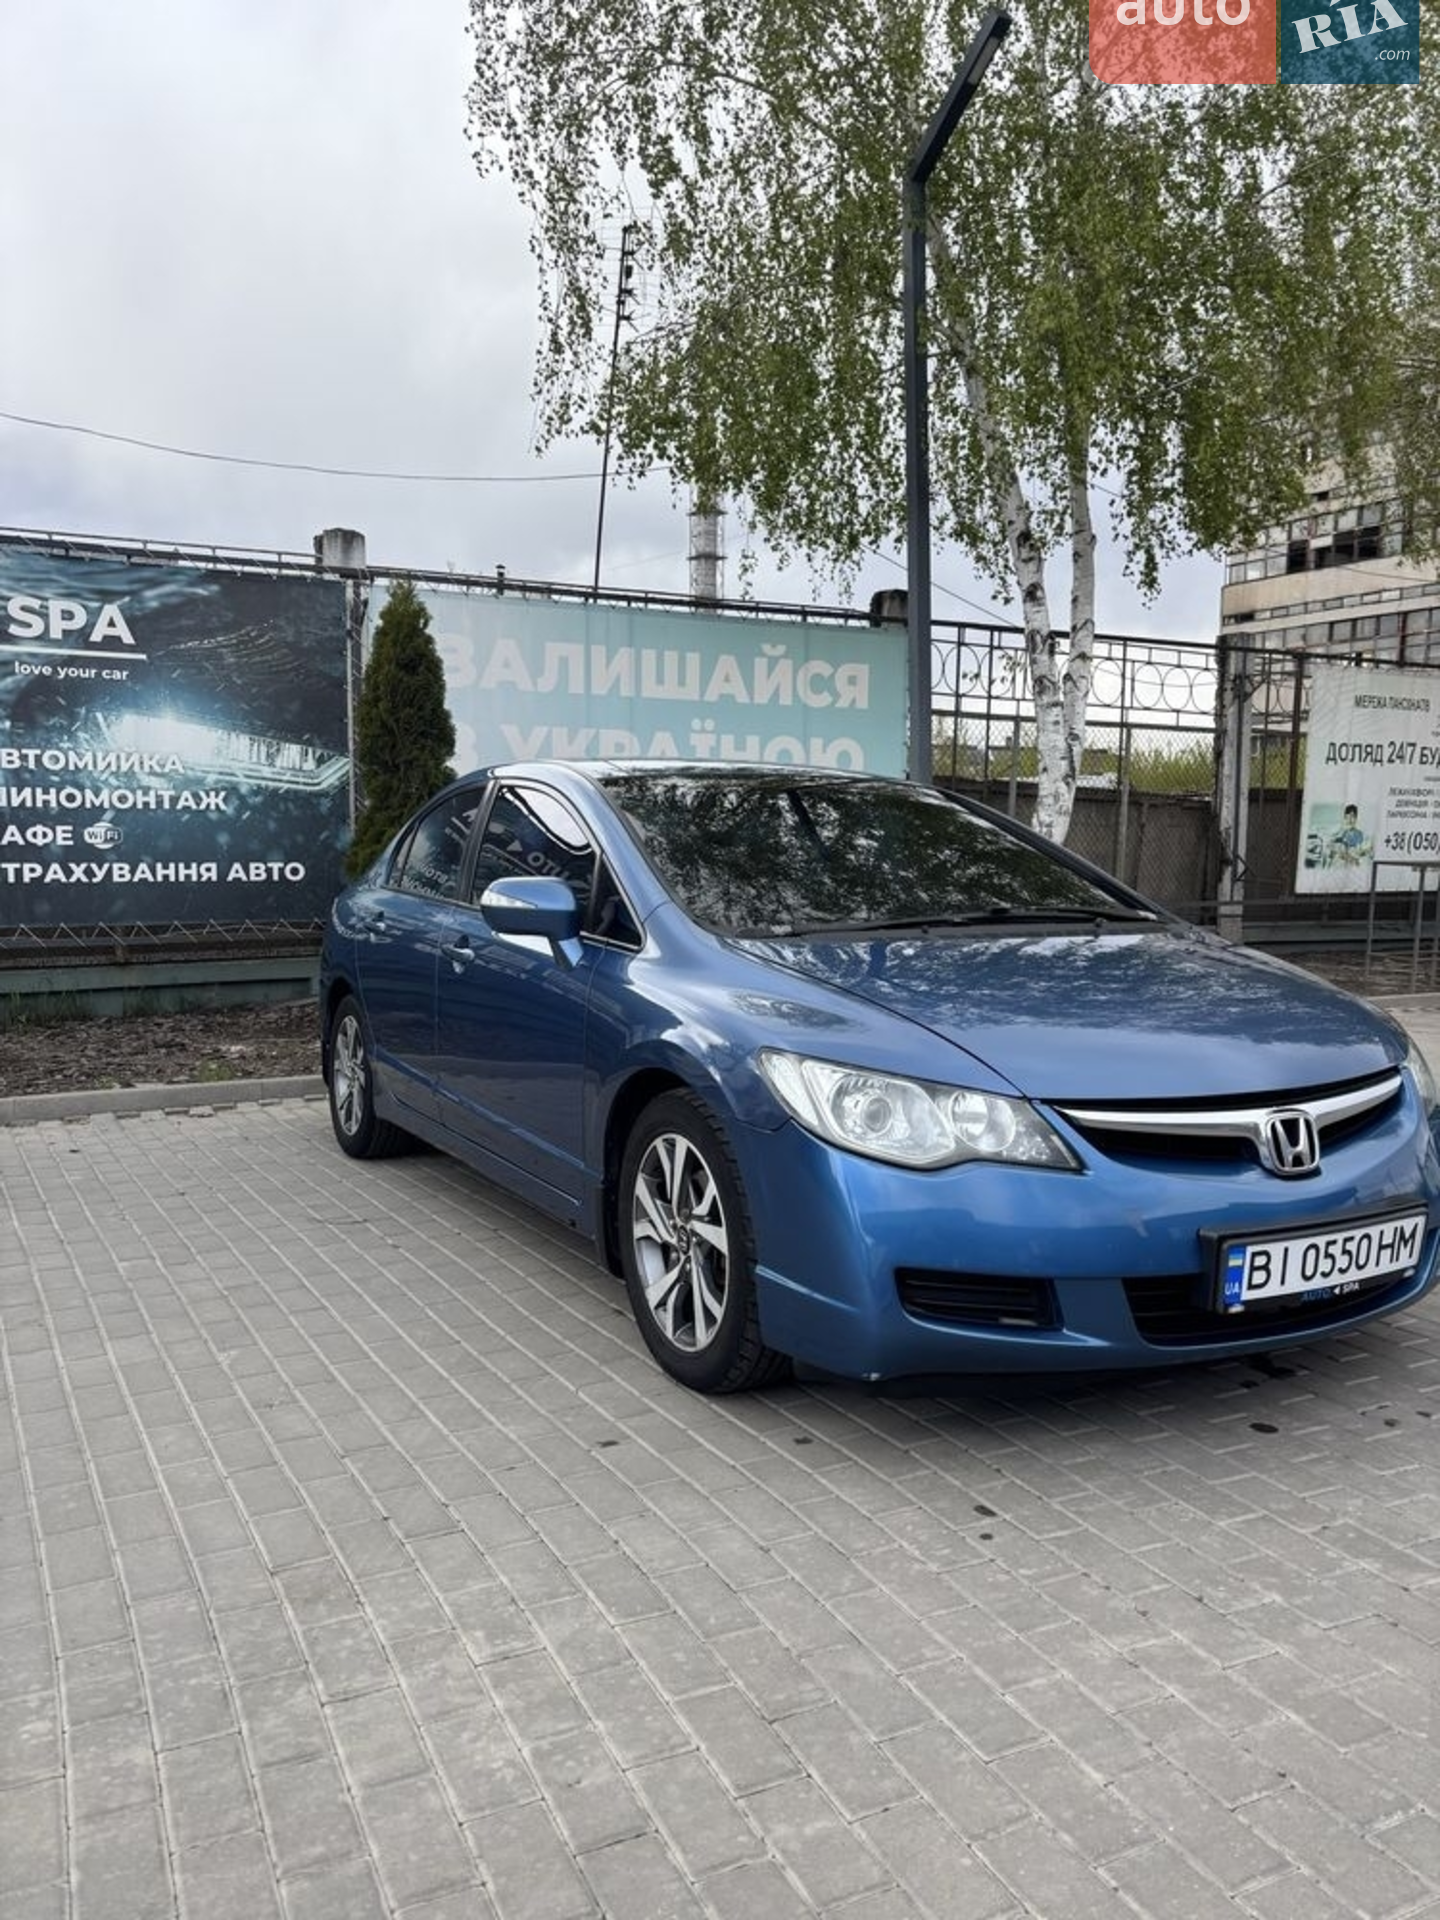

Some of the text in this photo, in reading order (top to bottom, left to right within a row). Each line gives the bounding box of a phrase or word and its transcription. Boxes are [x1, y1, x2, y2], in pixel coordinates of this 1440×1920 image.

[7, 595, 136, 645] SPA
[14, 660, 130, 681] love your car
[442, 633, 870, 710] ЗАЛИШАЙСЯ
[226, 861, 307, 882] АВТО
[1247, 1222, 1419, 1291] BI 0550 HM
[1224, 1284, 1239, 1296] UA
